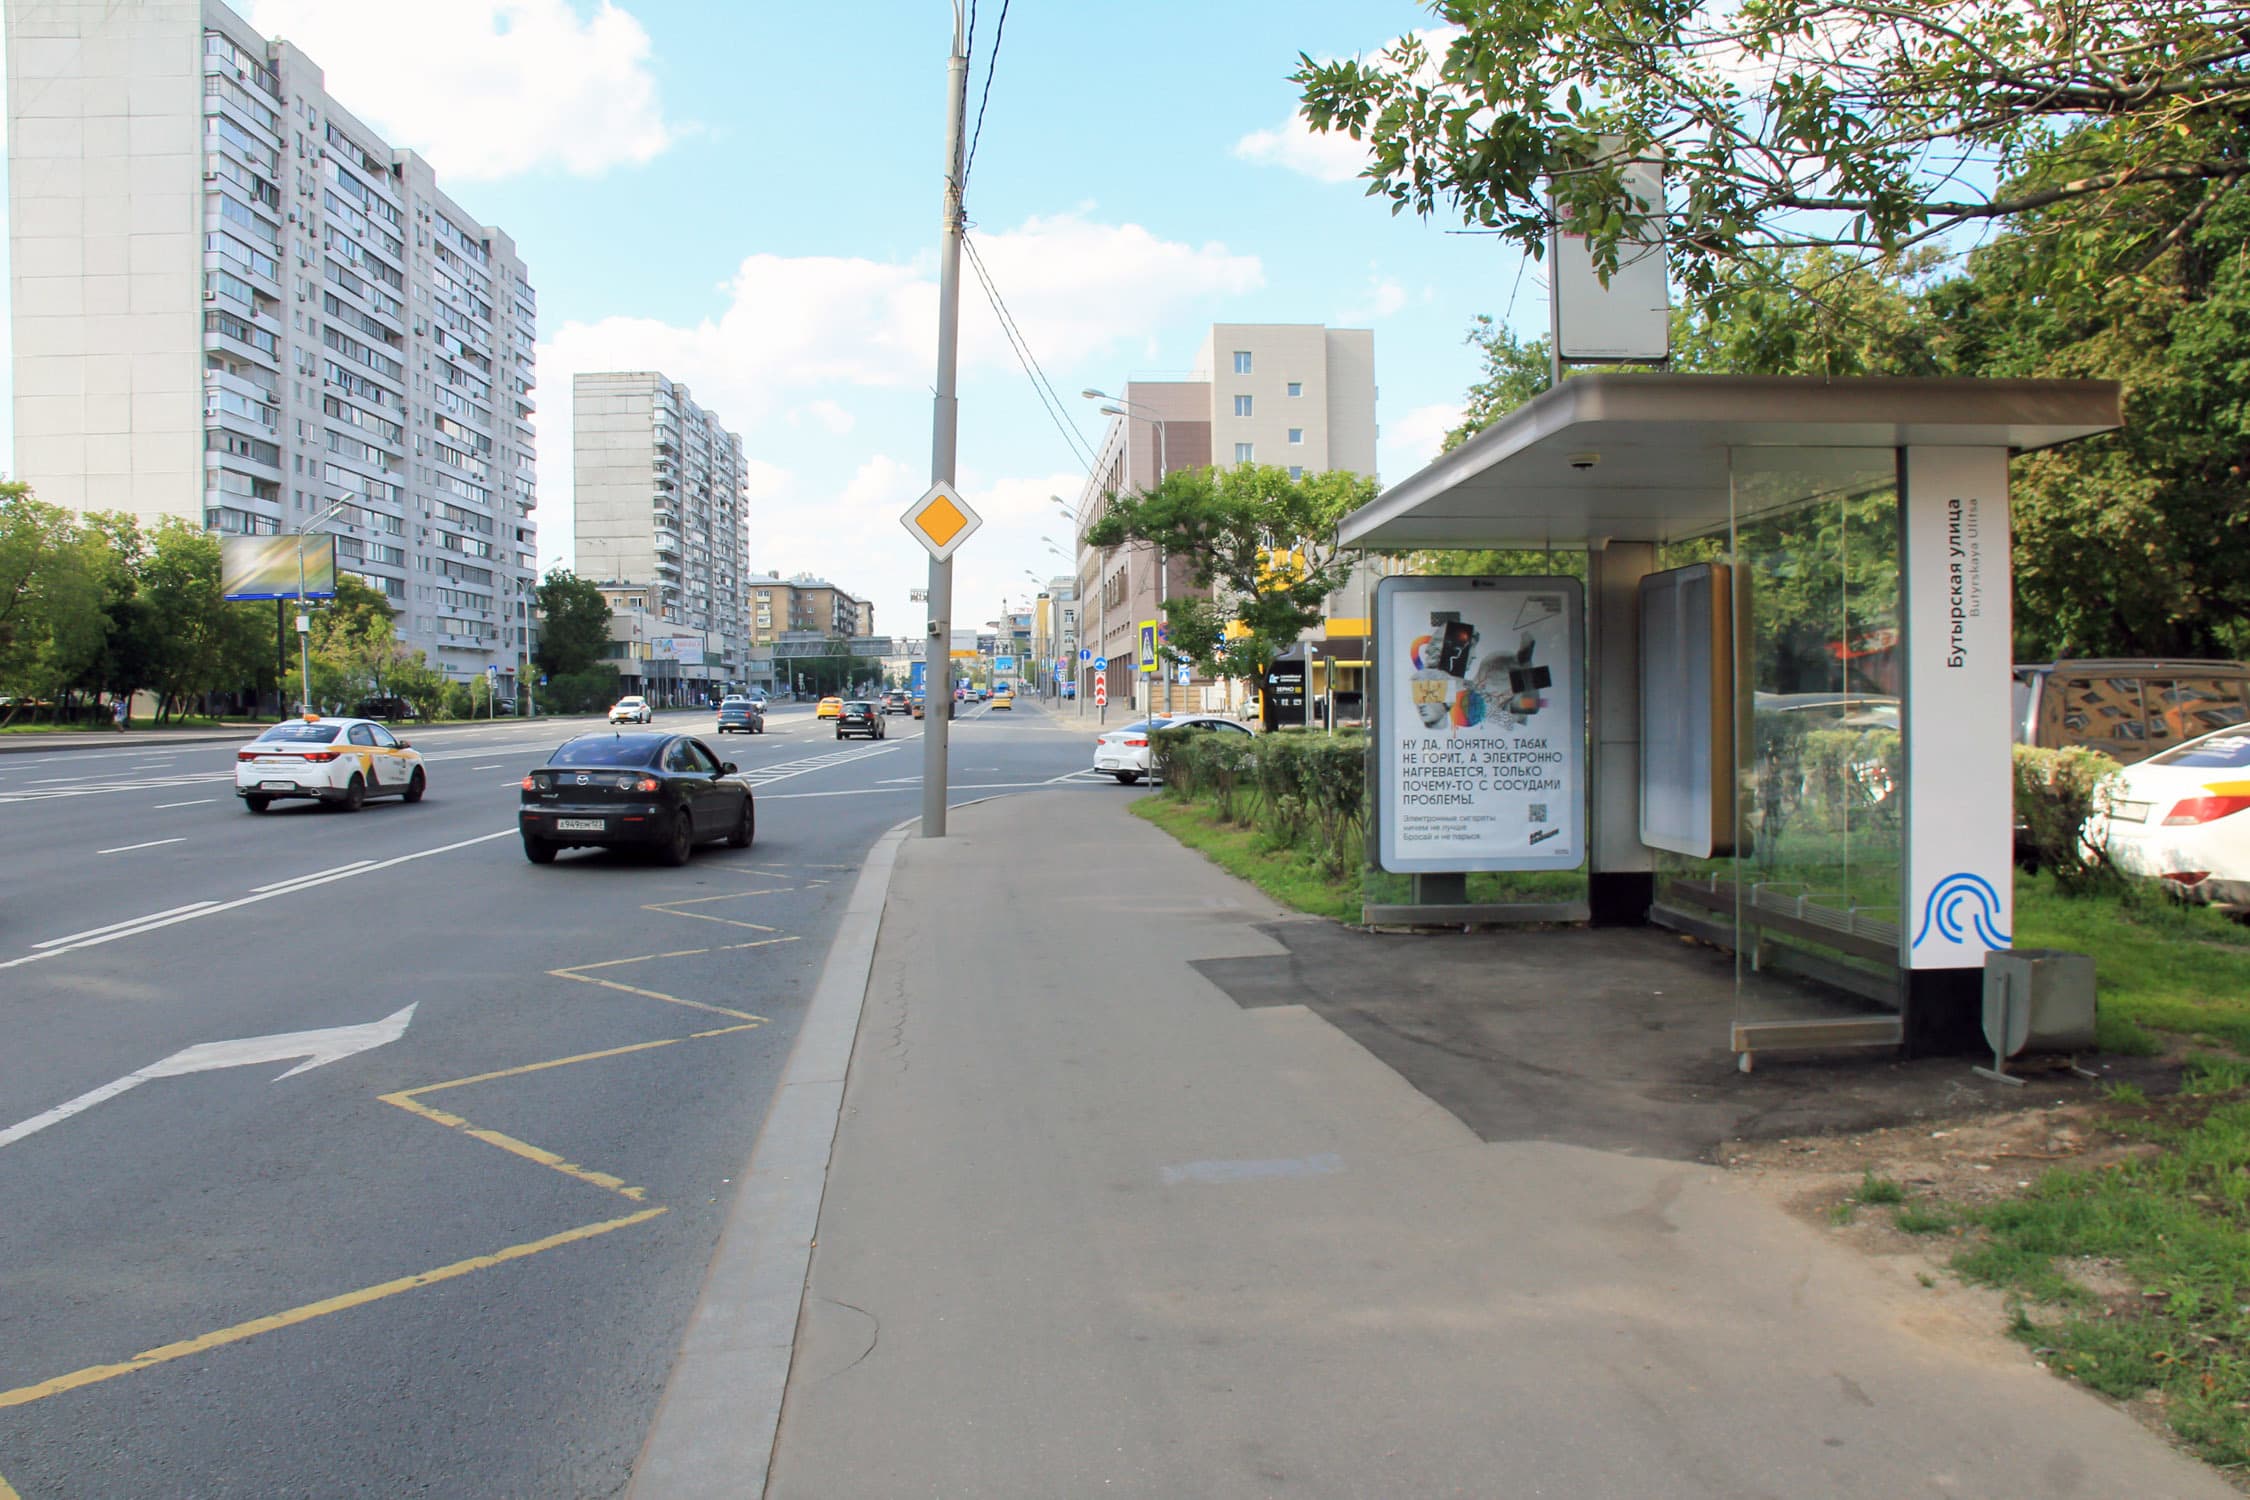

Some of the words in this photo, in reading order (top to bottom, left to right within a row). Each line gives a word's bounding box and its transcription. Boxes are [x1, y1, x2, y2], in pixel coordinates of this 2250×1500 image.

[1968, 498, 1978, 538] Ulitsa
[1948, 499, 1966, 557] улица
[1969, 543, 1981, 617] Butyrskaya
[1947, 563, 1966, 668] Бутырская
[1403, 739, 1416, 750] НУ
[1422, 739, 1441, 751] ДА,
[1446, 738, 1508, 750] ПОНЯТНО,
[1403, 753, 1416, 764] НЕ
[1422, 753, 1464, 764] ГОРИТ,
[1470, 752, 1477, 763] А
[1483, 752, 1562, 763] ЭЛЕКТРОННО
[1403, 766, 1487, 778] НАГРЕВАЕТСЯ,
[1493, 766, 1542, 777] ТОЛЬКО
[1403, 780, 1473, 791] ПОЧЕМУ-ТО
[1479, 780, 1488, 791] С
[1494, 779, 1561, 791] СОСУДАМИ
[1403, 815, 1457, 823] Электронные
[1459, 815, 1496, 823] сигареты
[1403, 832, 1432, 841] Бросай
